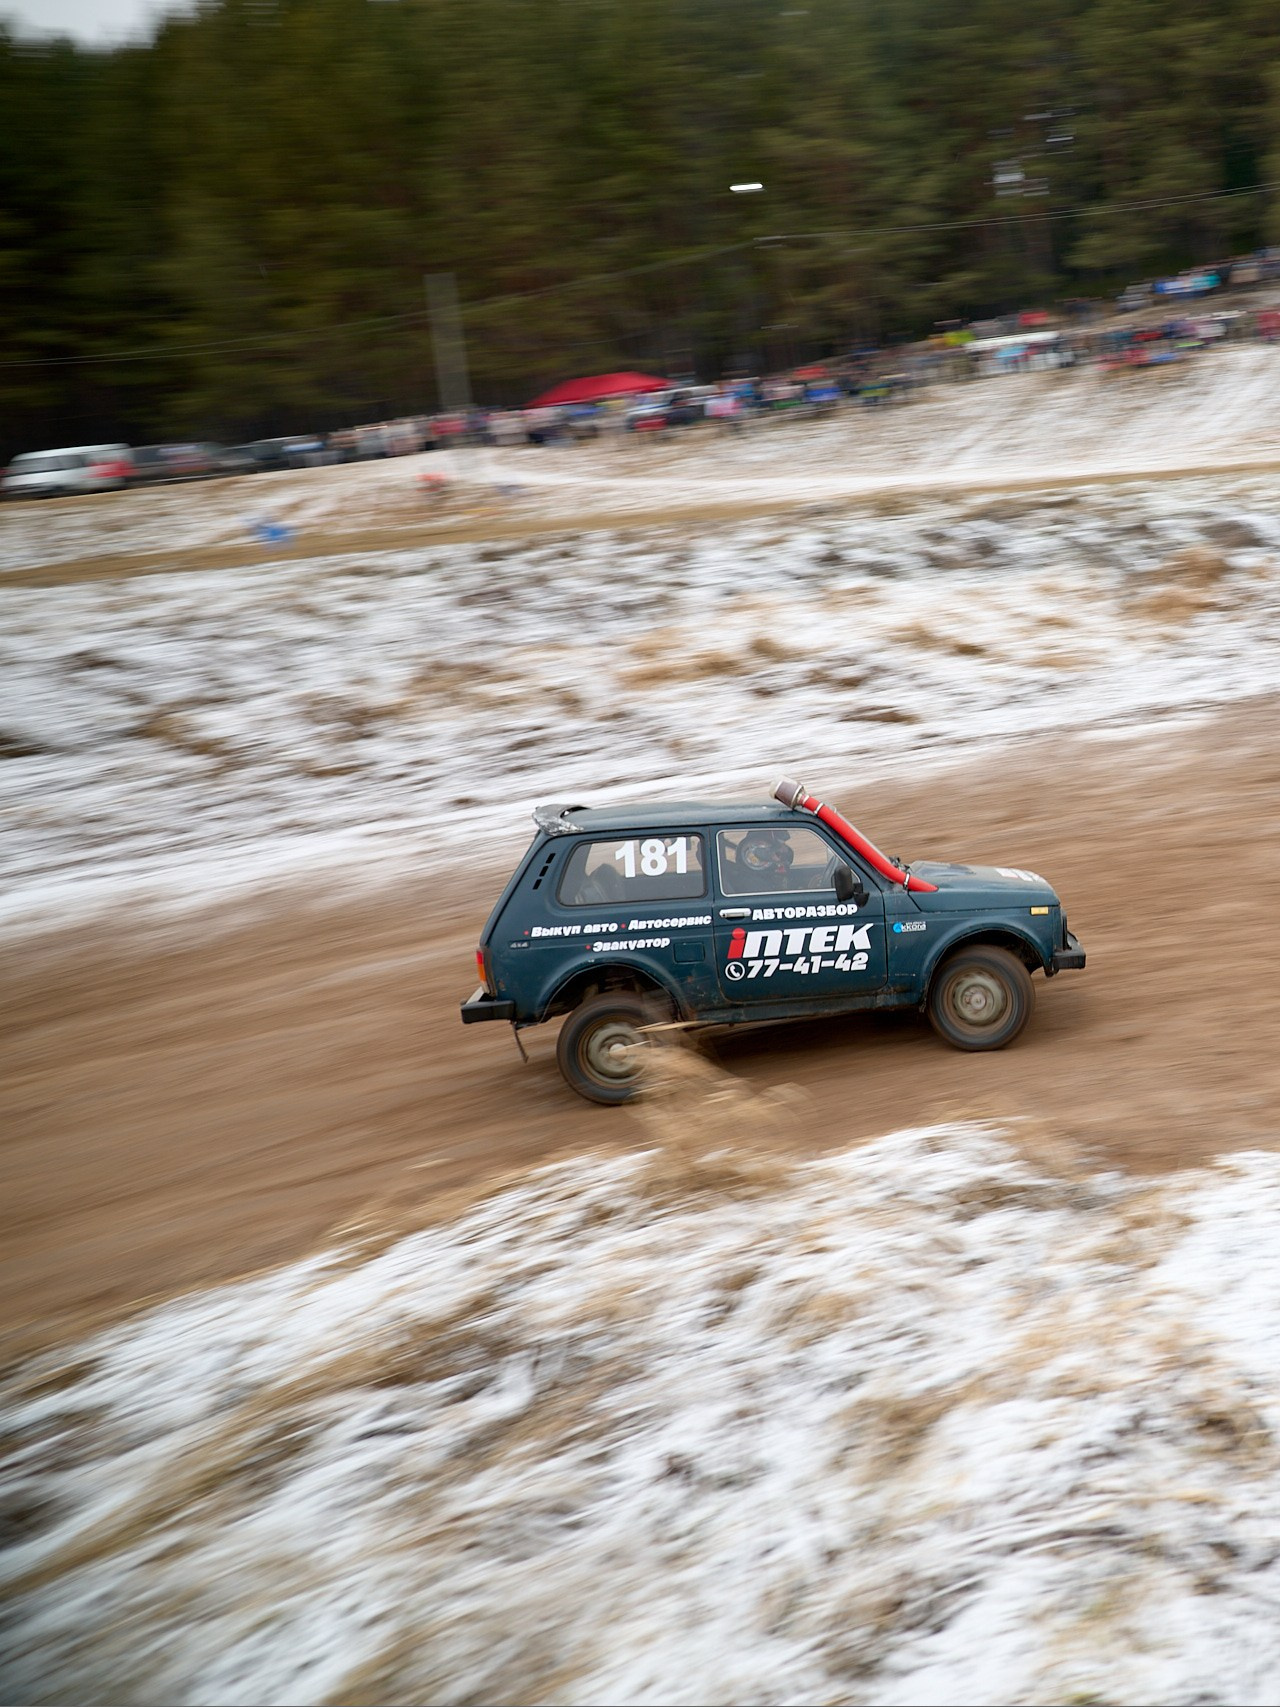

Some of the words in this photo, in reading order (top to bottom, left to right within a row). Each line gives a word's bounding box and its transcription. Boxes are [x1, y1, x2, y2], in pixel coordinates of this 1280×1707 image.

[615, 836, 687, 878] 181
[752, 904, 858, 921] АВТОРАЗБОР
[531, 924, 581, 938] Выкуп
[583, 922, 618, 934] авто
[628, 915, 712, 931] Автосервис
[592, 937, 670, 952] Эвакуатор
[747, 952, 869, 979] 77-41-42
